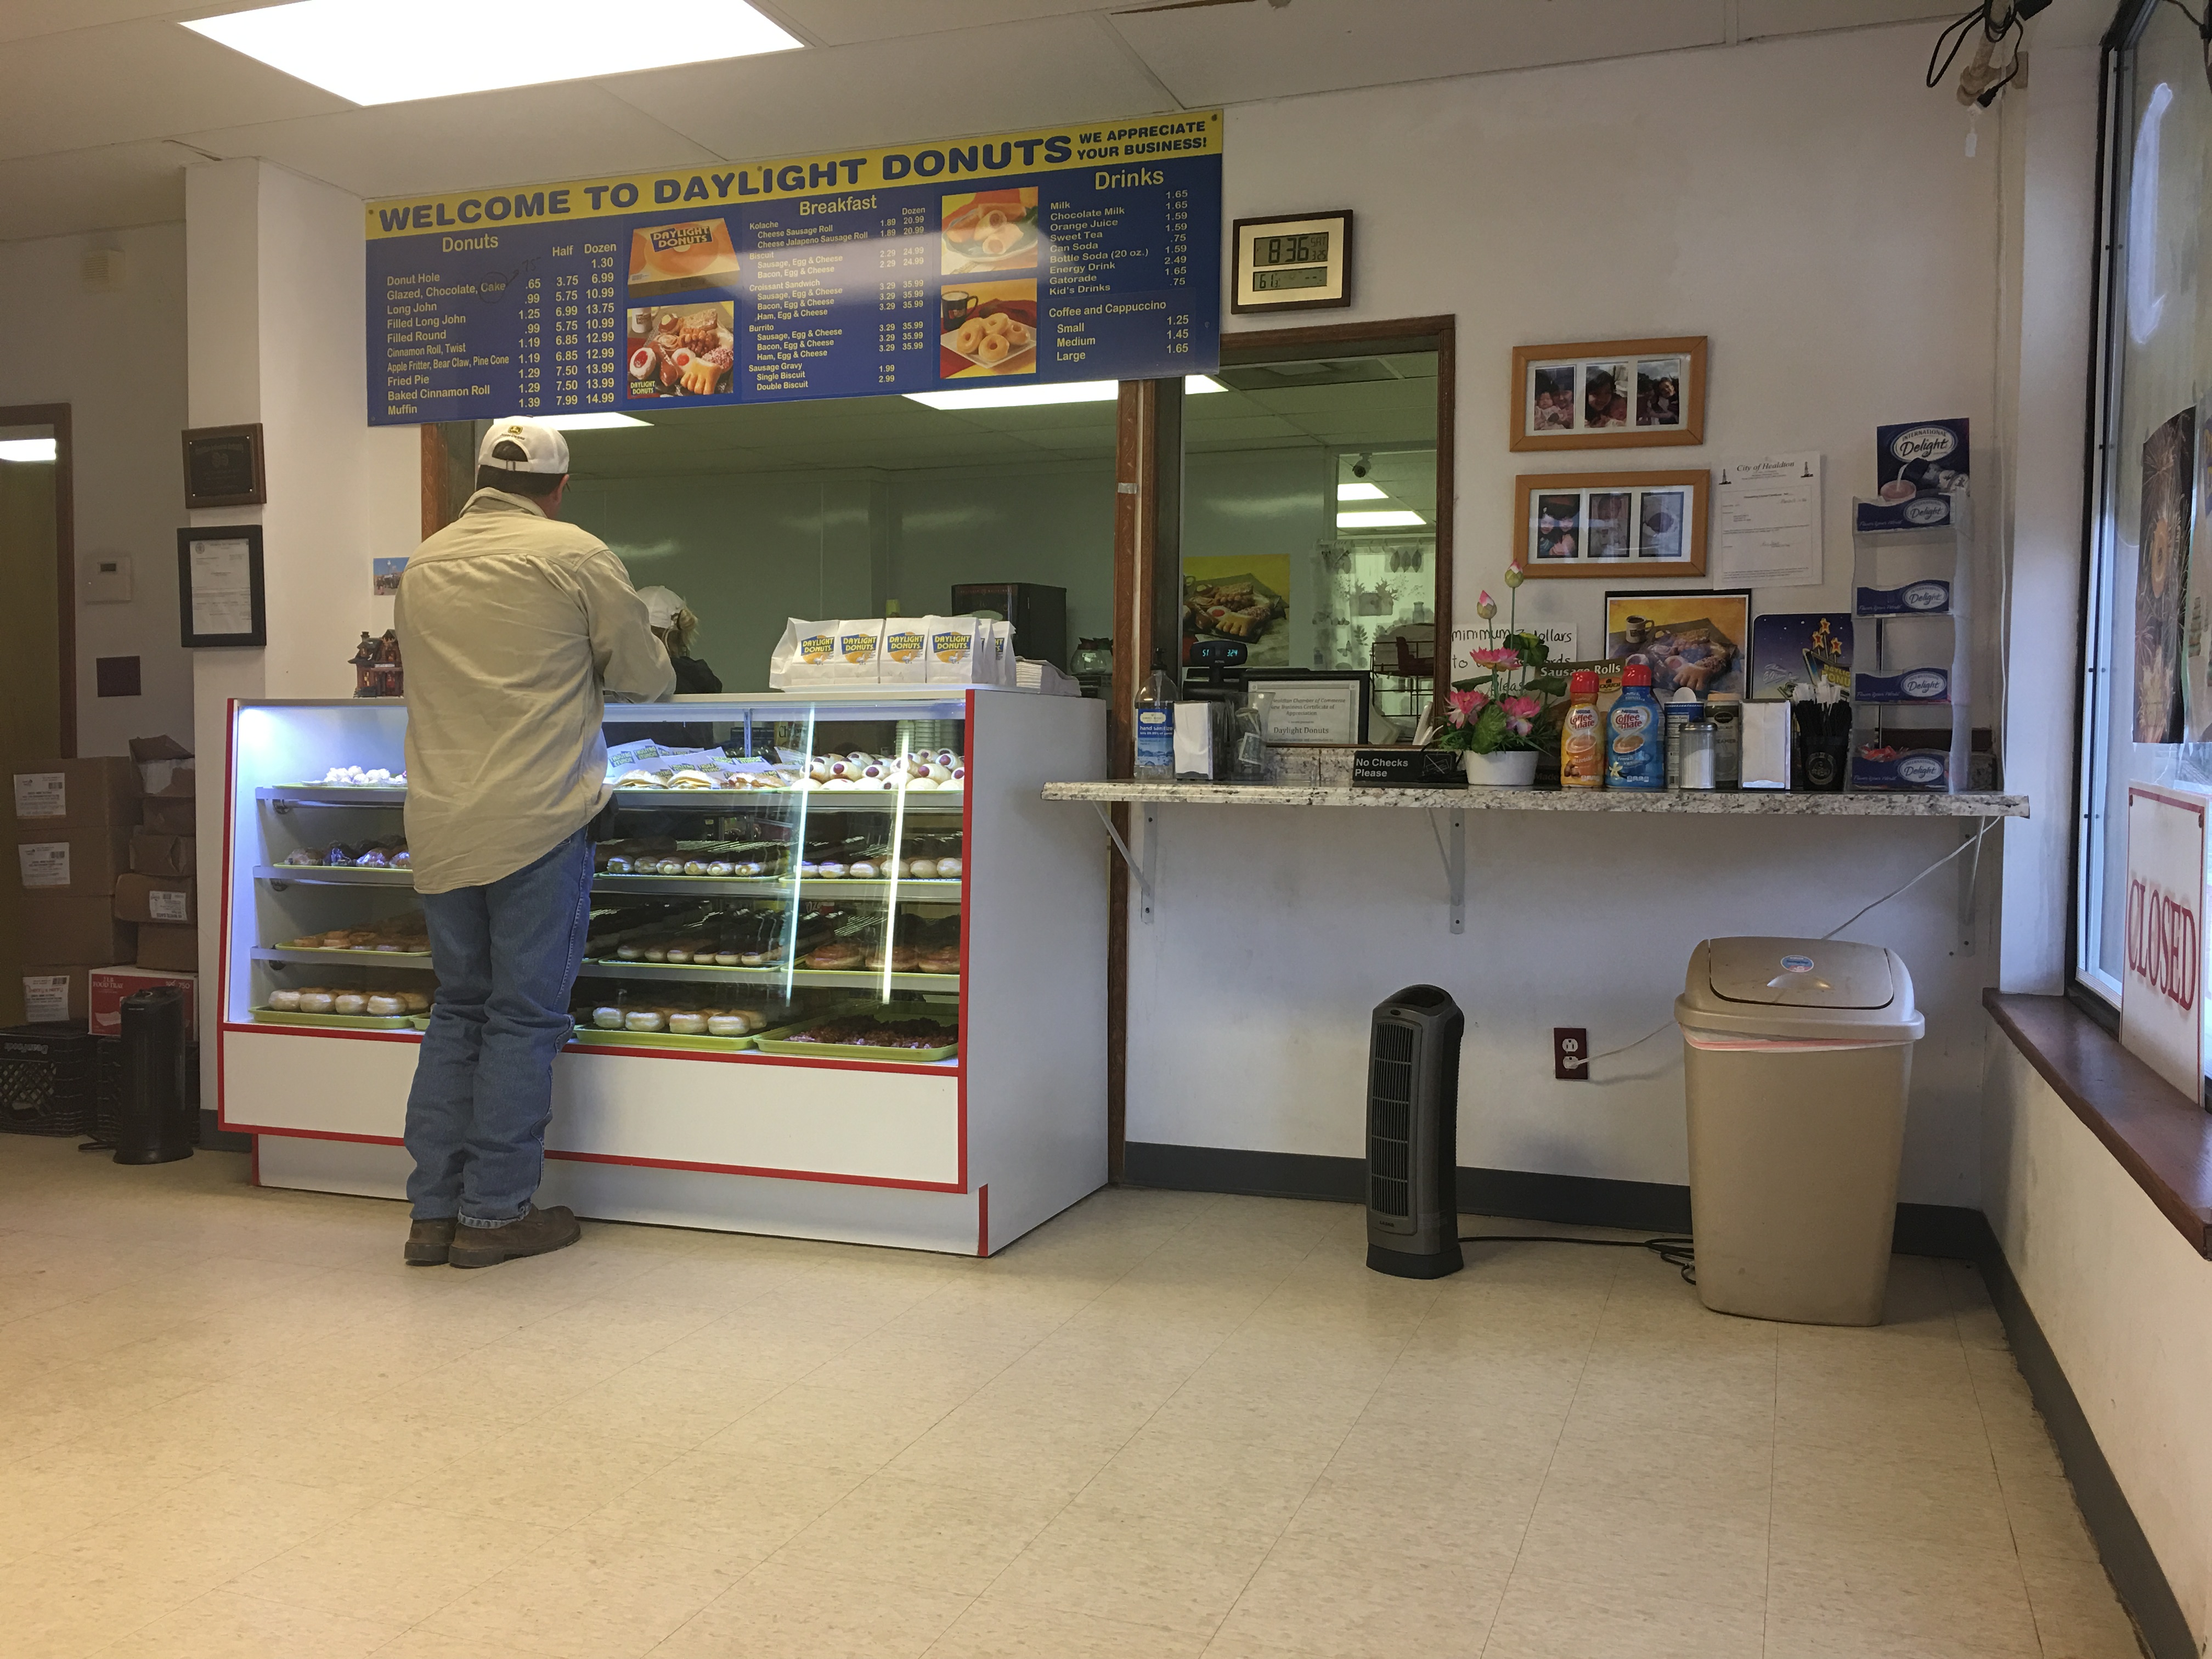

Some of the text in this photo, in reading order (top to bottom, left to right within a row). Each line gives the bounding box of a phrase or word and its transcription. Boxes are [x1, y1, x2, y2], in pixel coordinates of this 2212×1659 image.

[1079, 120, 1205, 144] WE APPRECIATE
[1076, 136, 1207, 160] YOUR BUSINESS!
[379, 134, 1072, 232] WELCOME TO DAYLIGHT DONUTS
[1094, 167, 1164, 190] Drinks
[799, 194, 877, 216] Breakfast
[1050, 189, 1188, 210] Milk 1.65
[901, 207, 926, 215] Dozen
[1049, 206, 1125, 221] Chocolate Milk
[749, 220, 778, 230] Kolache
[757, 215, 924, 239] Cheese Sausage Roll 1.89 20.99
[1049, 218, 1118, 232] Orange Juice
[653, 226, 709, 240] DAYLIGHT
[757, 230, 868, 249] Cheese Jalapeno Sausage Roll
[1049, 230, 1103, 241] Sweet Tea
[442, 233, 499, 252] Donuts
[658, 235, 707, 248] DONUTS
[1072, 241, 1098, 251] Soda
[552, 243, 617, 257] Half Dozen
[749, 250, 774, 260] Biscuit
[1049, 247, 1148, 263] Bottle Soda (20 oz.)
[386, 256, 613, 286] Donut Hole 1.30
[1049, 261, 1115, 274] Energy Drink
[386, 272, 614, 300] Glazed, Chocolate, Cake .65 3.75 6.99
[1049, 273, 1097, 285] Gatorade
[1049, 283, 1110, 295] Kid's Drinks
[386, 301, 437, 316] Long John
[1048, 300, 1166, 318] Coffee and Cappuccino
[387, 313, 466, 329] Filled Long John
[748, 323, 774, 332] Burrito
[1056, 314, 1189, 334] Small 1.25
[387, 329, 446, 343] Filled Round
[1057, 328, 1189, 347] Medium 1.45
[386, 342, 466, 358] Cinnamon Roll, Twist
[1056, 342, 1188, 362] Large 1.65
[386, 354, 509, 374] Apple Fritter, Bear Claw, Pine Cone
[387, 374, 430, 387] Fried Pie
[630, 381, 655, 389] DAYLIGHT
[387, 384, 490, 400] Baked Cinnamon Roll
[387, 403, 417, 415] Muffin
[1903, 429, 1946, 442] INTERNATIONAL
[1899, 438, 1949, 458] Delight
[1753, 463, 1762, 471] of
[1762, 461, 1795, 470] Healdton
[1910, 506, 1942, 520] Delight
[1909, 592, 1942, 605] Delight
[803, 637, 834, 647] DAYLIGHT
[1451, 629, 1510, 642] minimum
[1453, 654, 1468, 668] to
[1594, 663, 1621, 674] Rolls
[1824, 664, 1851, 676] DAYLIG
[1908, 680, 1940, 693] Delight
[1570, 714, 1593, 725] Coffee
[1575, 720, 1595, 729] mate
[1615, 714, 1640, 725] Coffee
[1621, 720, 1643, 730] mate
[1274, 727, 1302, 735] Daylight
[1356, 758, 1408, 767] No Checks
[1355, 769, 1387, 777] Please
[1904, 765, 1937, 778] Delight
[2128, 879, 2195, 1011] CLOSED
